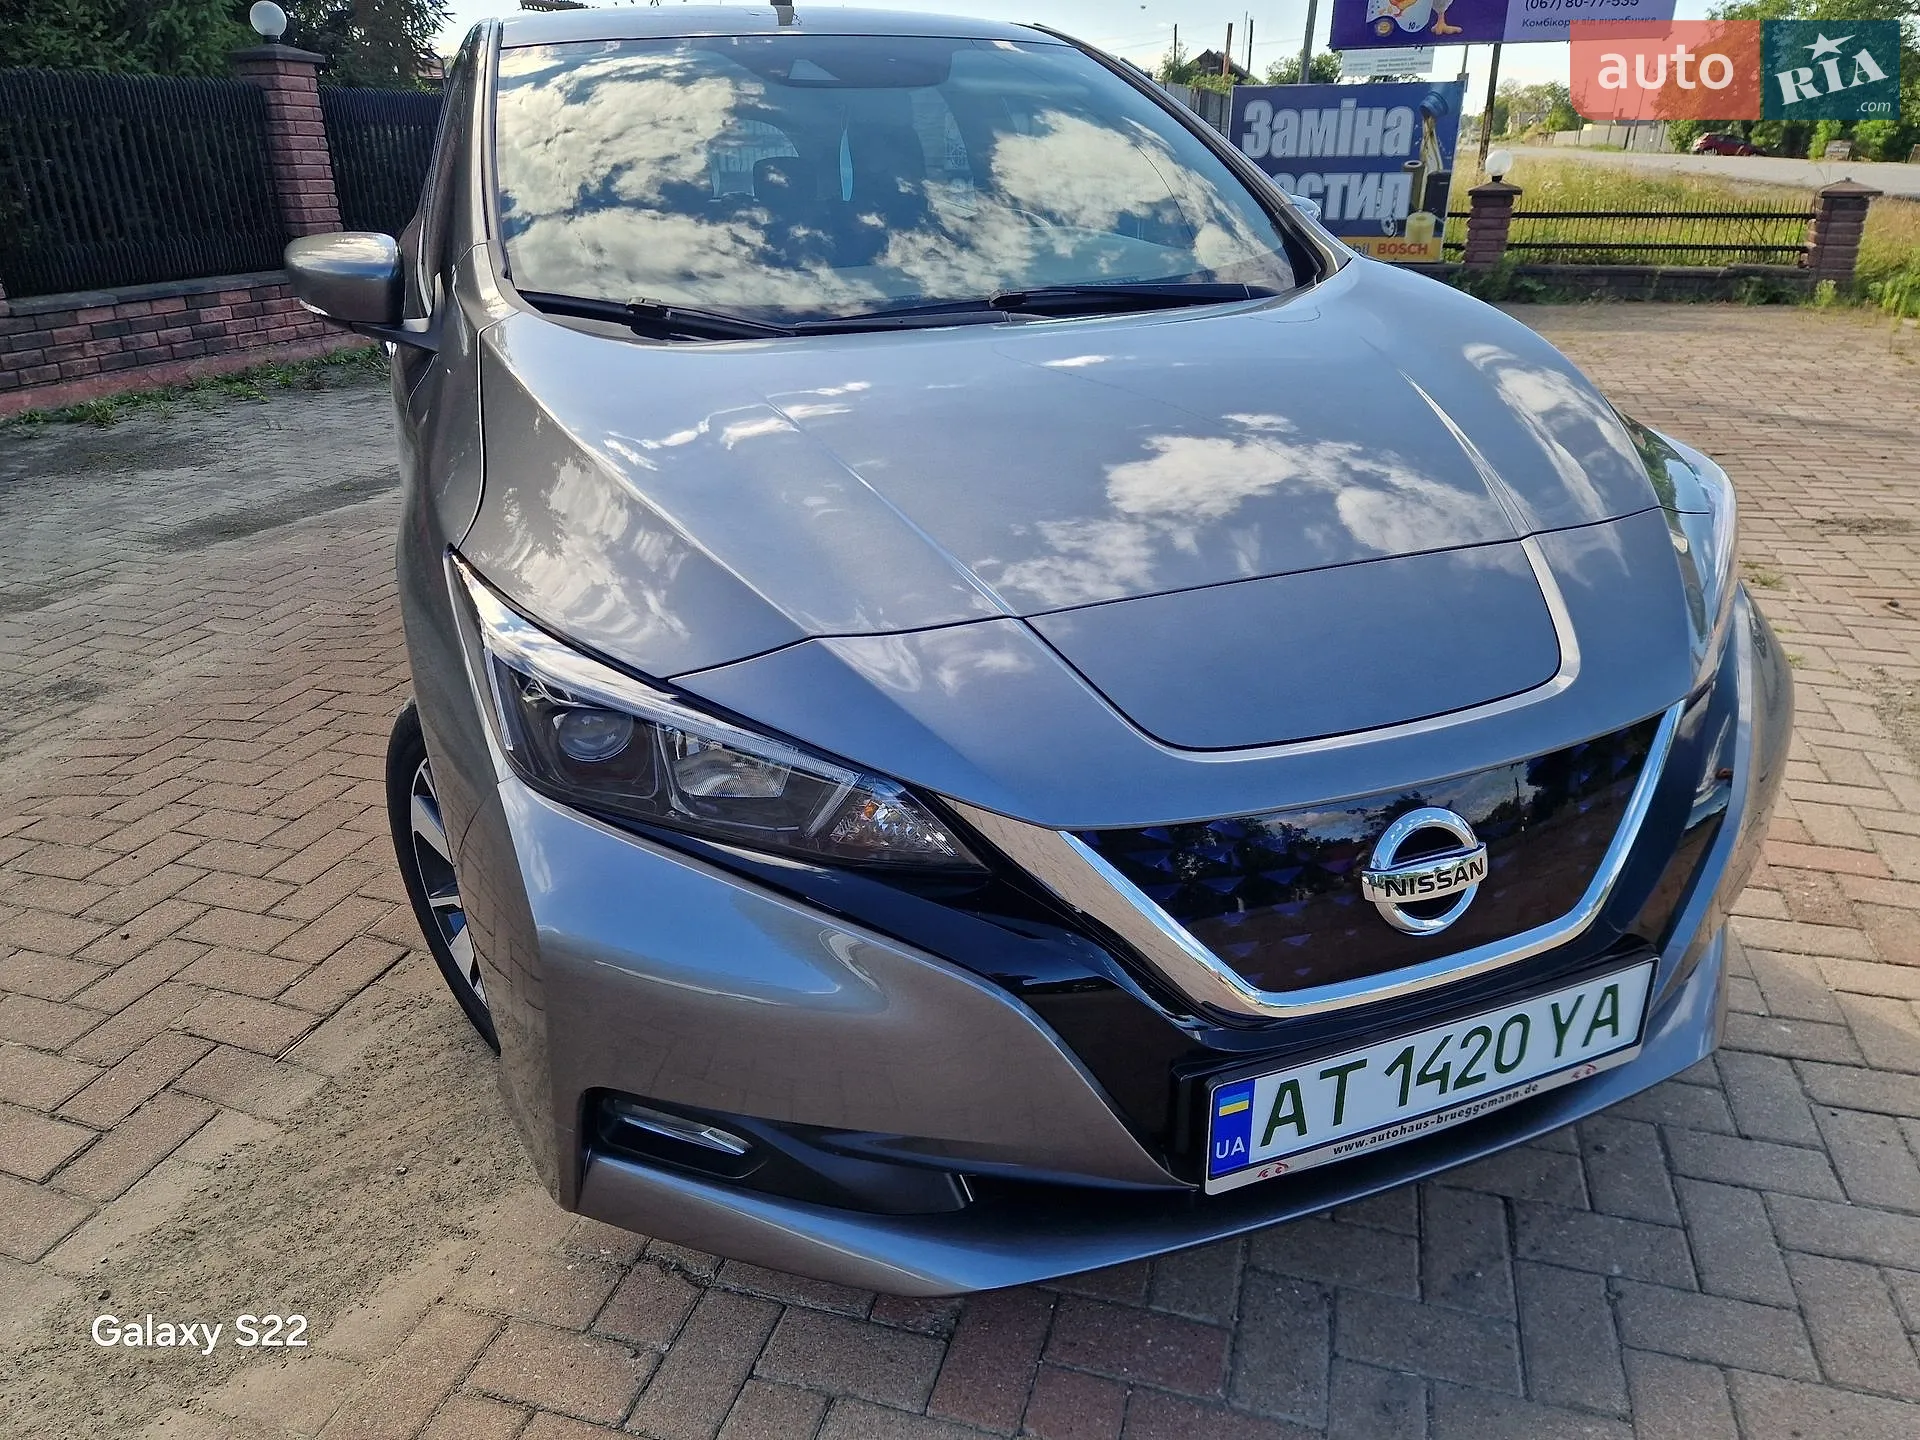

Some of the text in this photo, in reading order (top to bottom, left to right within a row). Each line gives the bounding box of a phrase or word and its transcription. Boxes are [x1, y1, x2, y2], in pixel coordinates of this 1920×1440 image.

[1241, 98, 1415, 159] Заміна
[1376, 243, 1428, 255] BOSCH
[1384, 857, 1484, 898] NISSAN
[1215, 983, 1620, 1160] UA AT 1420 YA
[1332, 1082, 1539, 1155] www.autohaus-brueggemann.de
